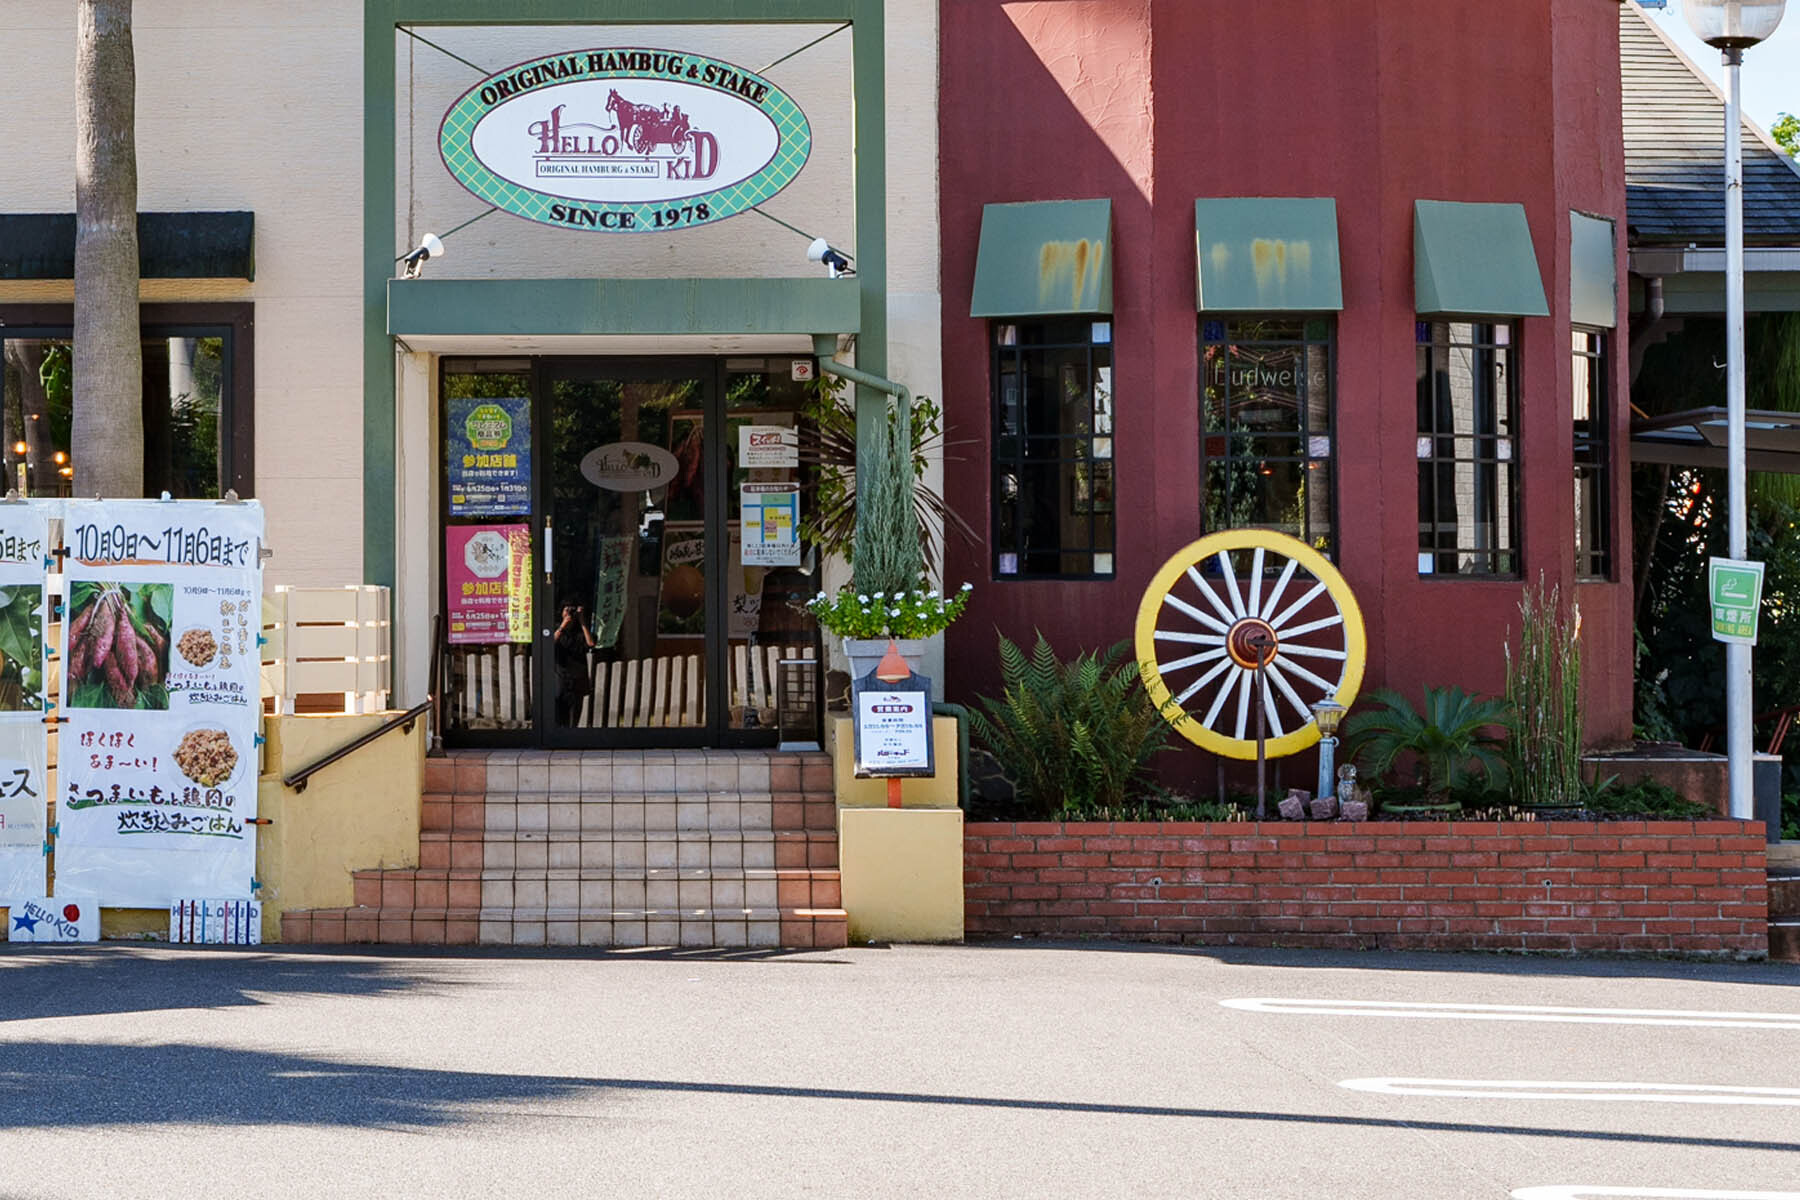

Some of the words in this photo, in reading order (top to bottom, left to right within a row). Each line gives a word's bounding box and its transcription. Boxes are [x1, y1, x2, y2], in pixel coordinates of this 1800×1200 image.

[480, 56, 583, 105] ORIGINAL
[586, 52, 683, 75] HAMBUG
[686, 64, 699, 79] &
[702, 63, 769, 104] STAKE
[528, 104, 620, 156] HELLO
[539, 164, 579, 175] ORIGINAL
[581, 164, 624, 175] HAMBURG
[630, 164, 656, 175] STAKE
[550, 204, 636, 229] SINCE
[653, 203, 710, 228] 1978
[462, 454, 517, 468] 参加店舗
[1715, 607, 1753, 625] 喫煙所
[80, 731, 135, 748] ほくほく
[68, 782, 236, 808] さつまいもと鶏肉の
[117, 809, 243, 834] 炊き込みごはん
[23, 900, 54, 923] HELLO
[53, 918, 80, 938] KID
